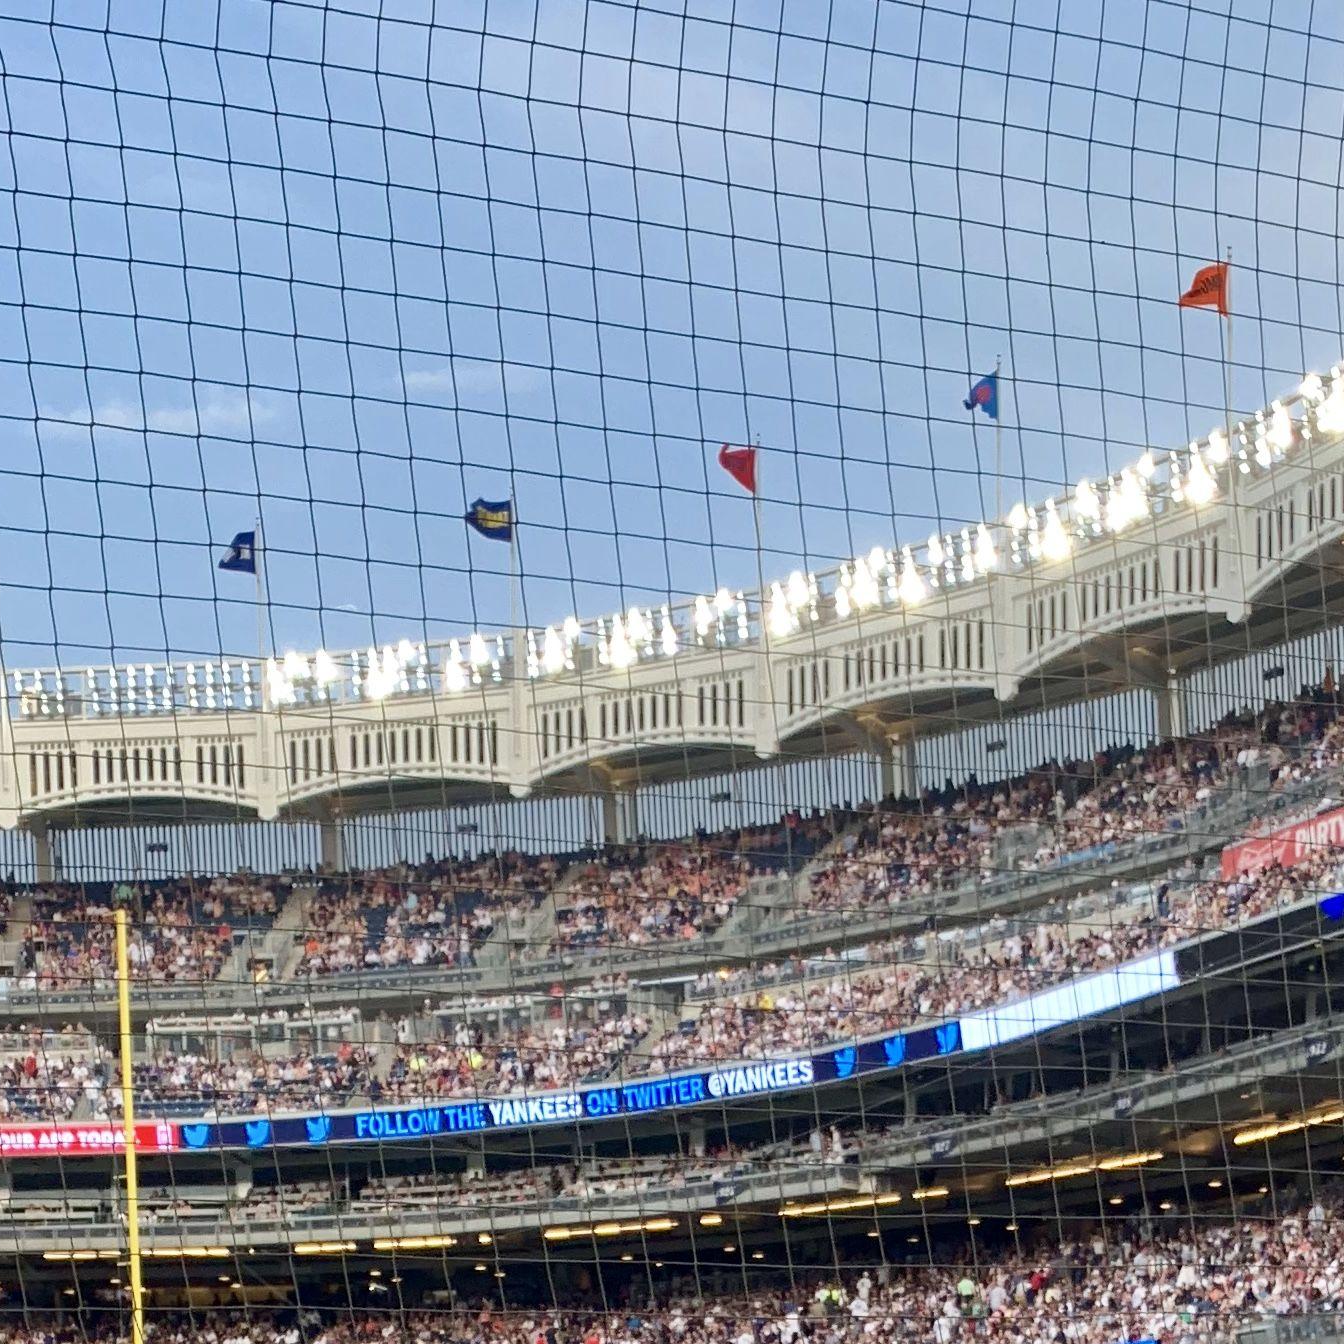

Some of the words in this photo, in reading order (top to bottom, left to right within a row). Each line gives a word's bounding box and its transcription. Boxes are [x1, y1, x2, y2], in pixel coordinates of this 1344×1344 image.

[356, 1107, 441, 1139] FOLLOW
[443, 1104, 485, 1130] THE
[489, 1094, 583, 1126] YANKEES
[586, 1089, 619, 1116] ON
[622, 1076, 705, 1113] TWITTER
[707, 1061, 815, 1098] @YANKEES
